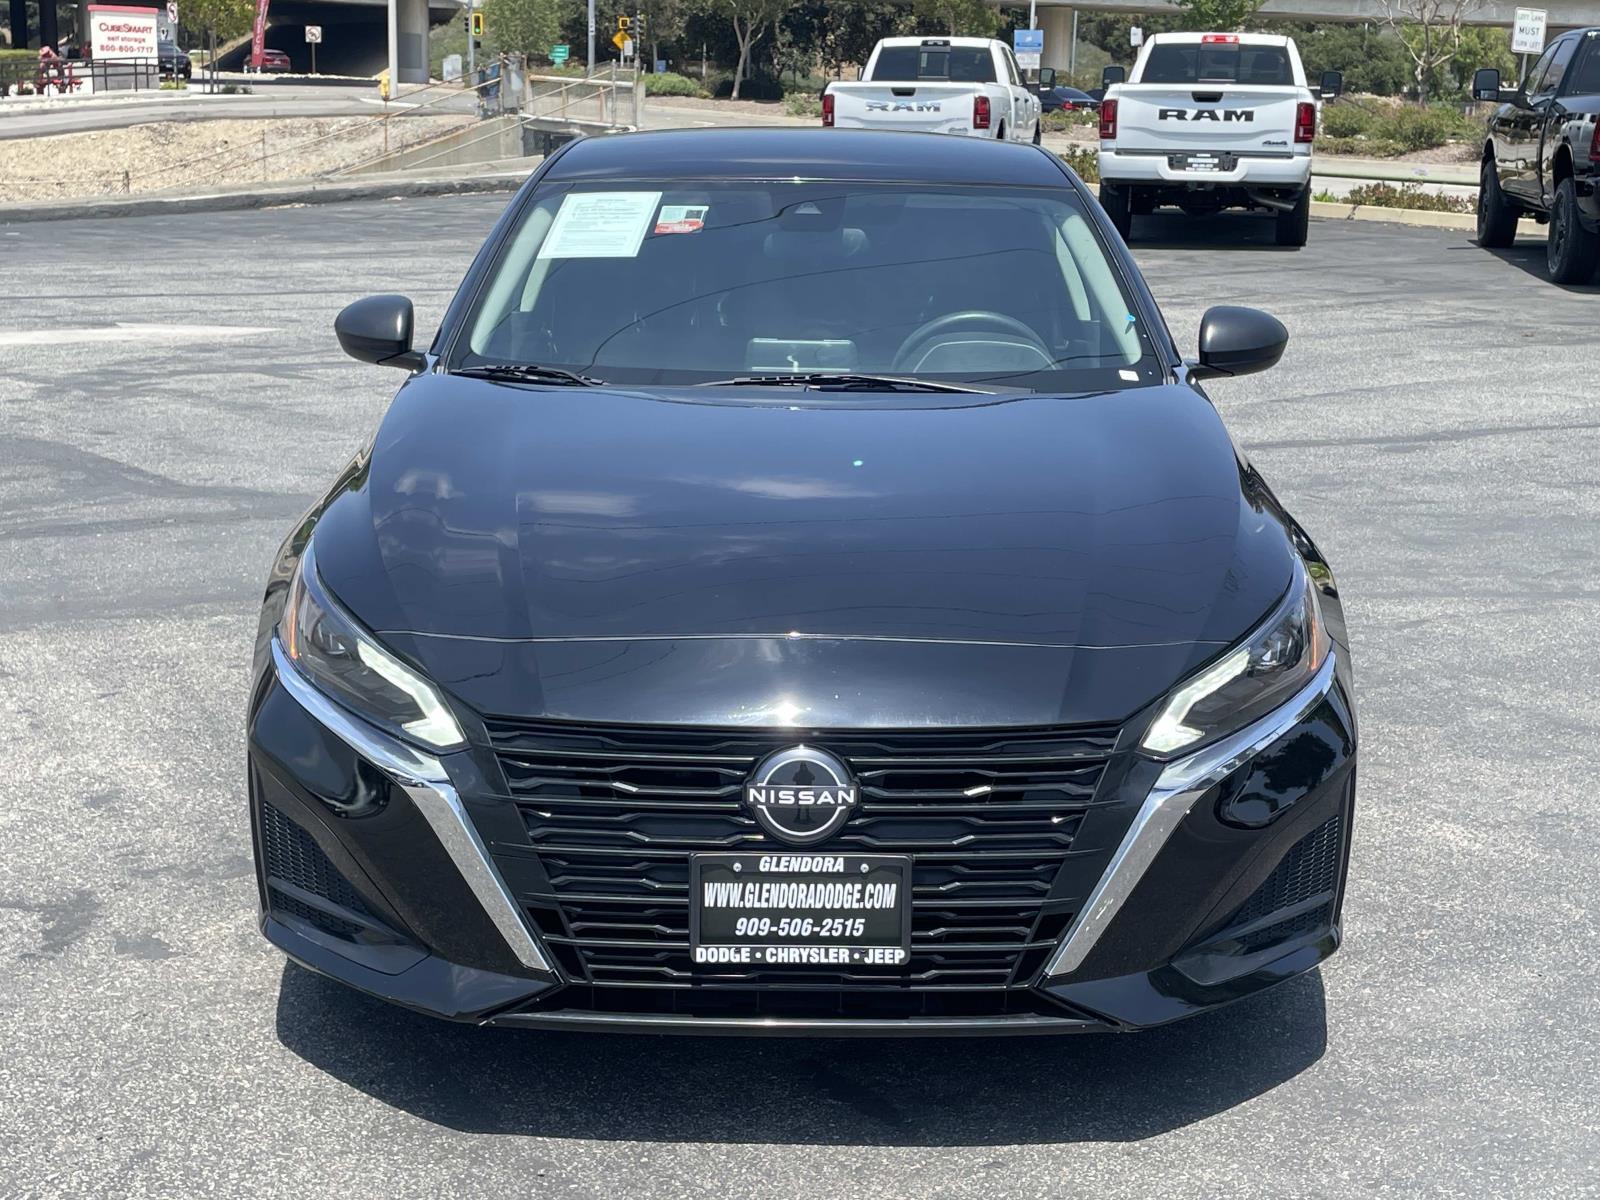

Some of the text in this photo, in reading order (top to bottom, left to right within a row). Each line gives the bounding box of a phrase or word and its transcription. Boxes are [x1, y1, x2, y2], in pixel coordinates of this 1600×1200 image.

[1518, 26, 1540, 36] MUST
[865, 100, 942, 112] RAM
[1158, 108, 1255, 122] RAM
[748, 788, 855, 805] NISSAN
[759, 856, 844, 872] GLENDORA
[703, 882, 897, 909] WWW.GLENDORADODGE.COM
[735, 917, 865, 937] 909-506-2515
[695, 947, 906, 964] DODGE CHRYSLER JEEP
